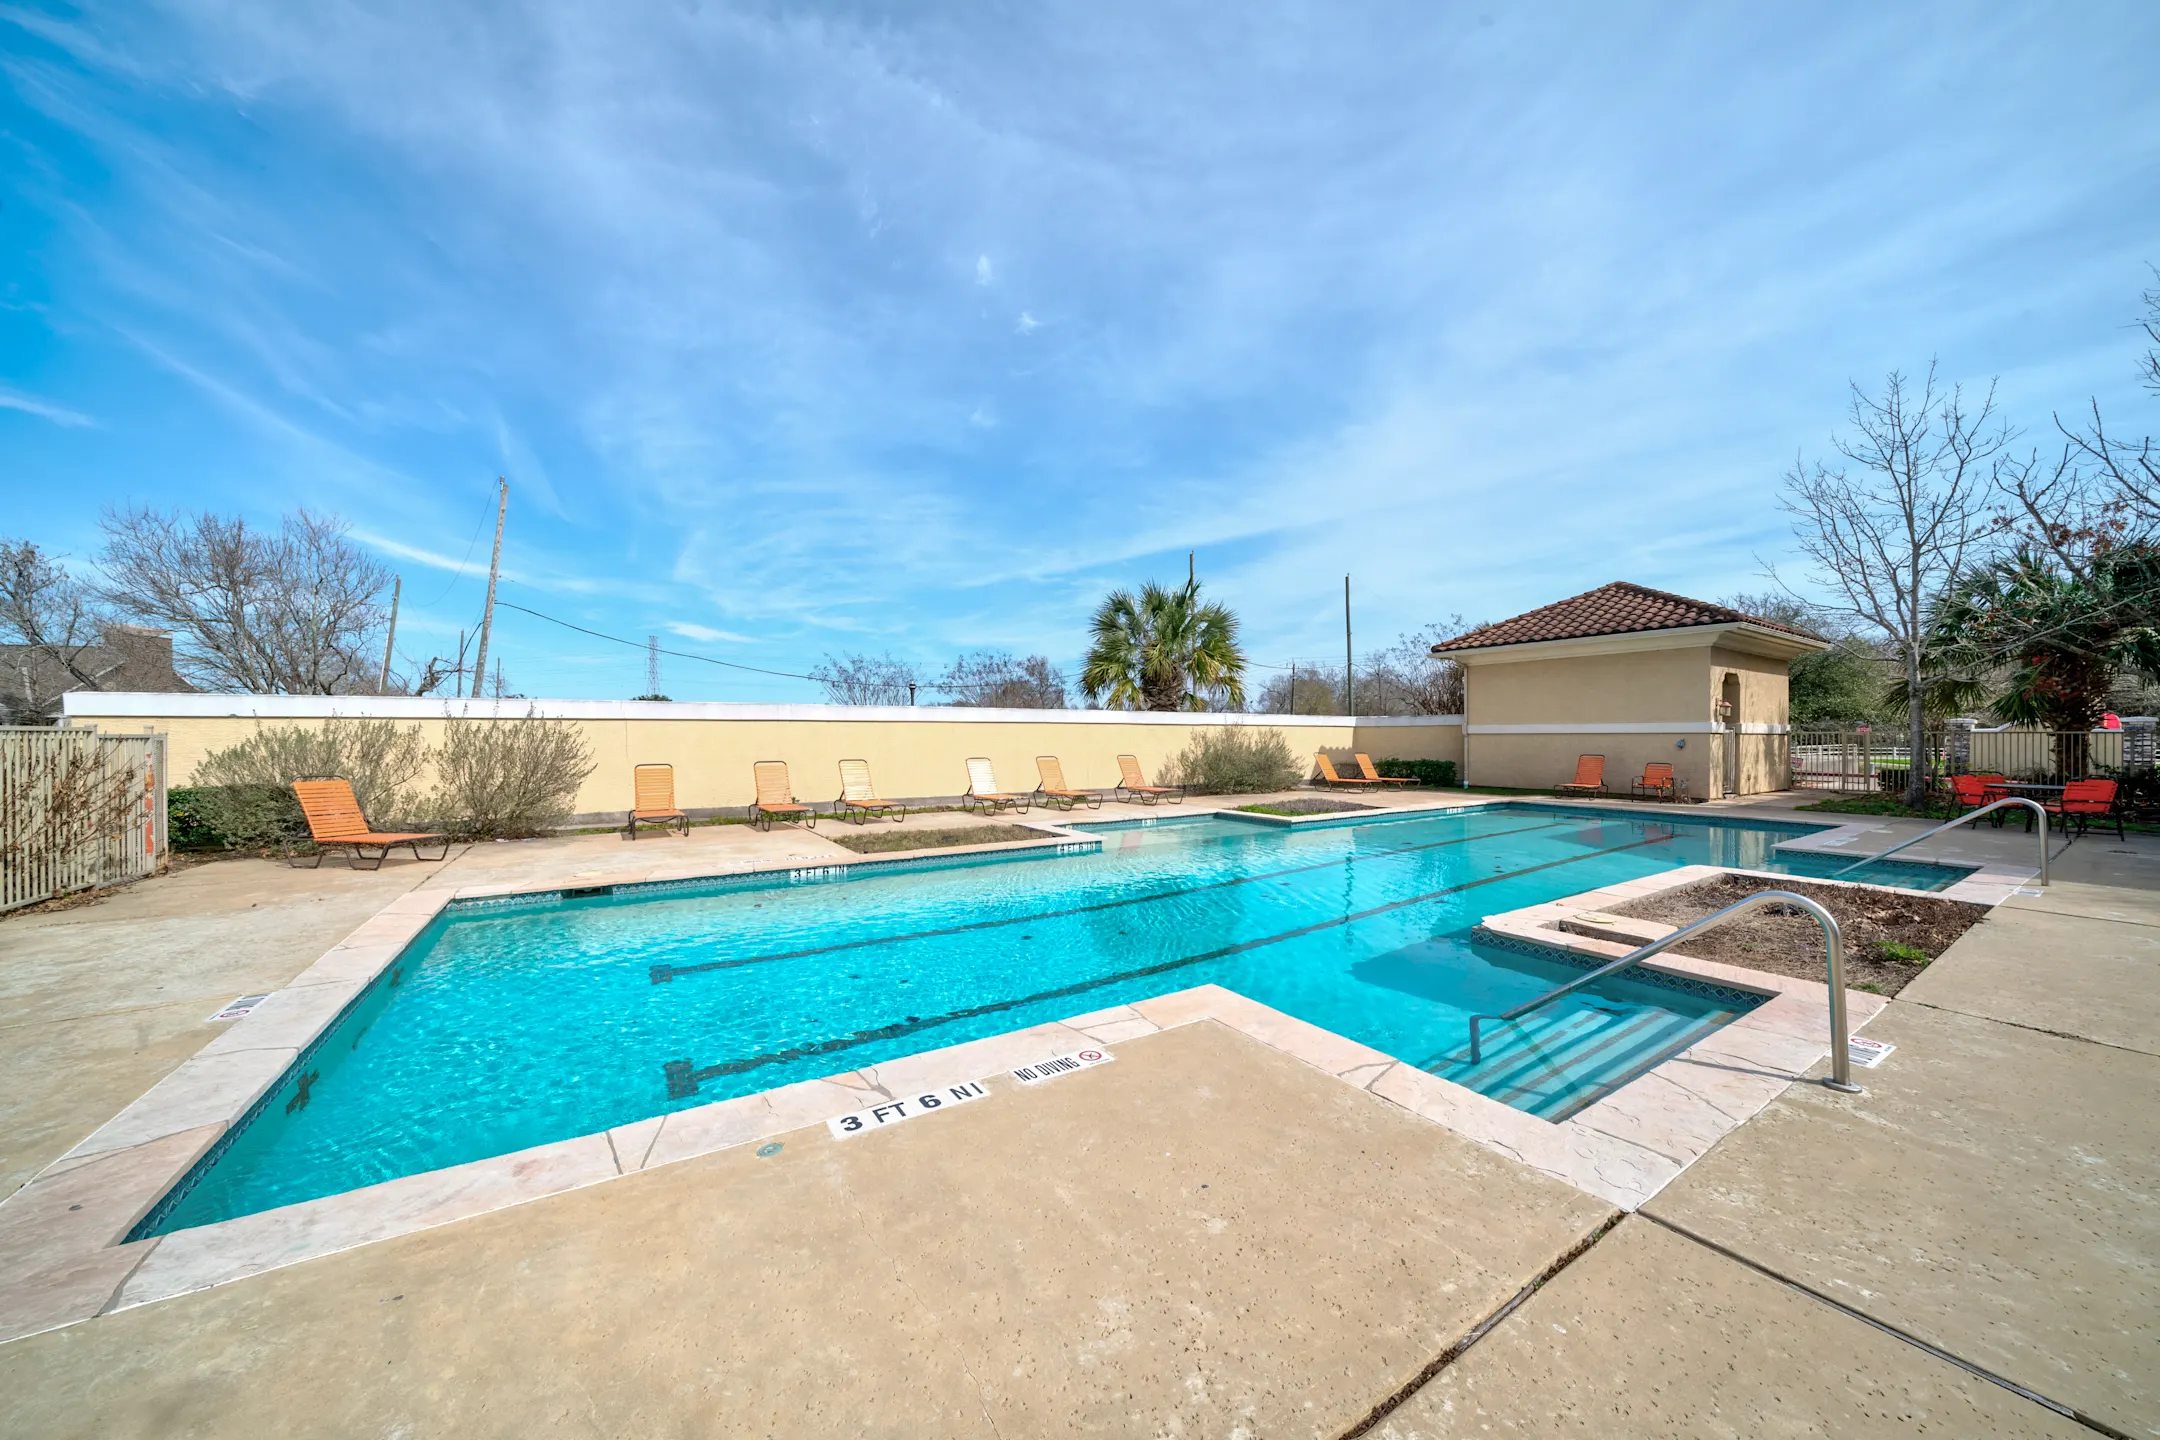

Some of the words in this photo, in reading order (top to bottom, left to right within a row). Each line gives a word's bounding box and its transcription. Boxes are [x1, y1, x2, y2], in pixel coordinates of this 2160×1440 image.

[795, 868, 801, 878] 3
[806, 867, 817, 877] FT
[834, 864, 845, 874] IN
[1013, 1068, 1038, 1082] NO
[1034, 1057, 1081, 1076] DIVING
[840, 1116, 863, 1132] 3
[872, 1102, 907, 1123] FT
[918, 1094, 942, 1109] 6
